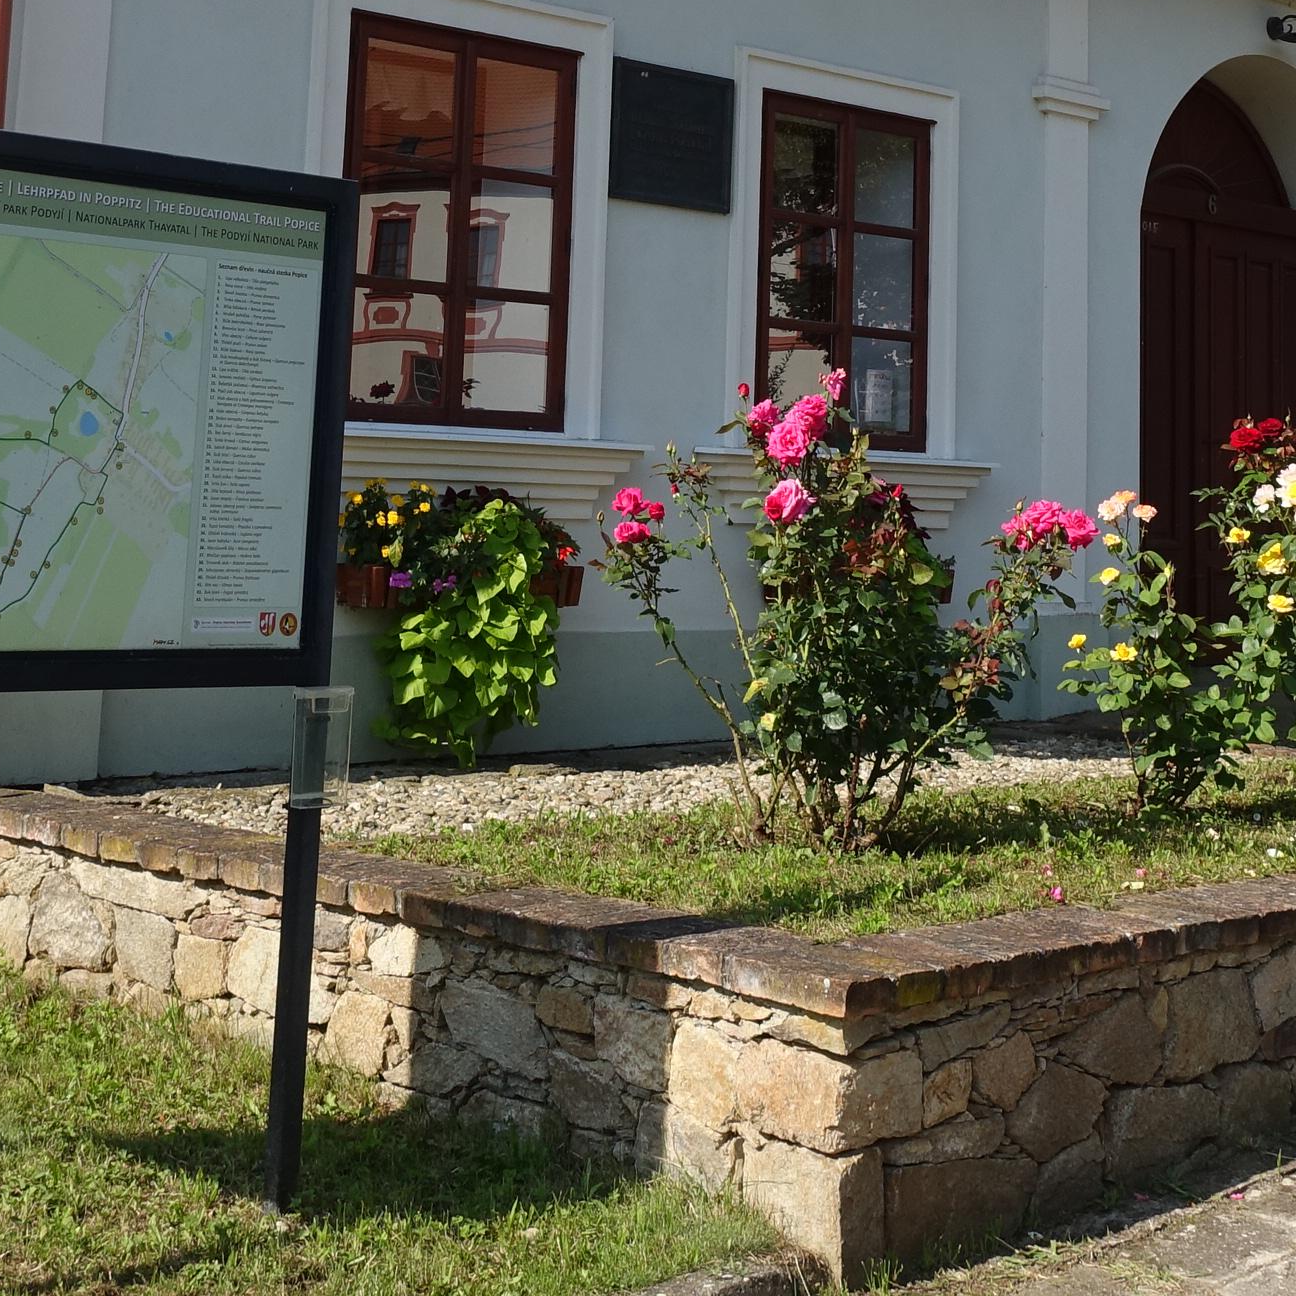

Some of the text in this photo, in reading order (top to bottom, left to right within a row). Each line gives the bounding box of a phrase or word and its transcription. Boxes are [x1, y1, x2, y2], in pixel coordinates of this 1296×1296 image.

[3, 204, 28, 216] PARK
[31, 205, 65, 221] PODYJÍ
[75, 210, 146, 230] NATIONALPARK
[148, 219, 191, 236] THAYATAL
[201, 226, 219, 239] THE
[221, 227, 251, 242] PODYJÍ
[253, 232, 296, 248] NATIONAL
[297, 237, 319, 251] PARK
[17, 182, 76, 202] LEHRPFAD
[79, 192, 92, 204] IN
[95, 192, 143, 211] POPPITZ
[154, 200, 176, 214] THE
[178, 203, 251, 224] EDUCATIONAL
[253, 212, 282, 228] TRAIL
[284, 216, 321, 233] POPICE
[1208, 194, 1217, 215] 6
